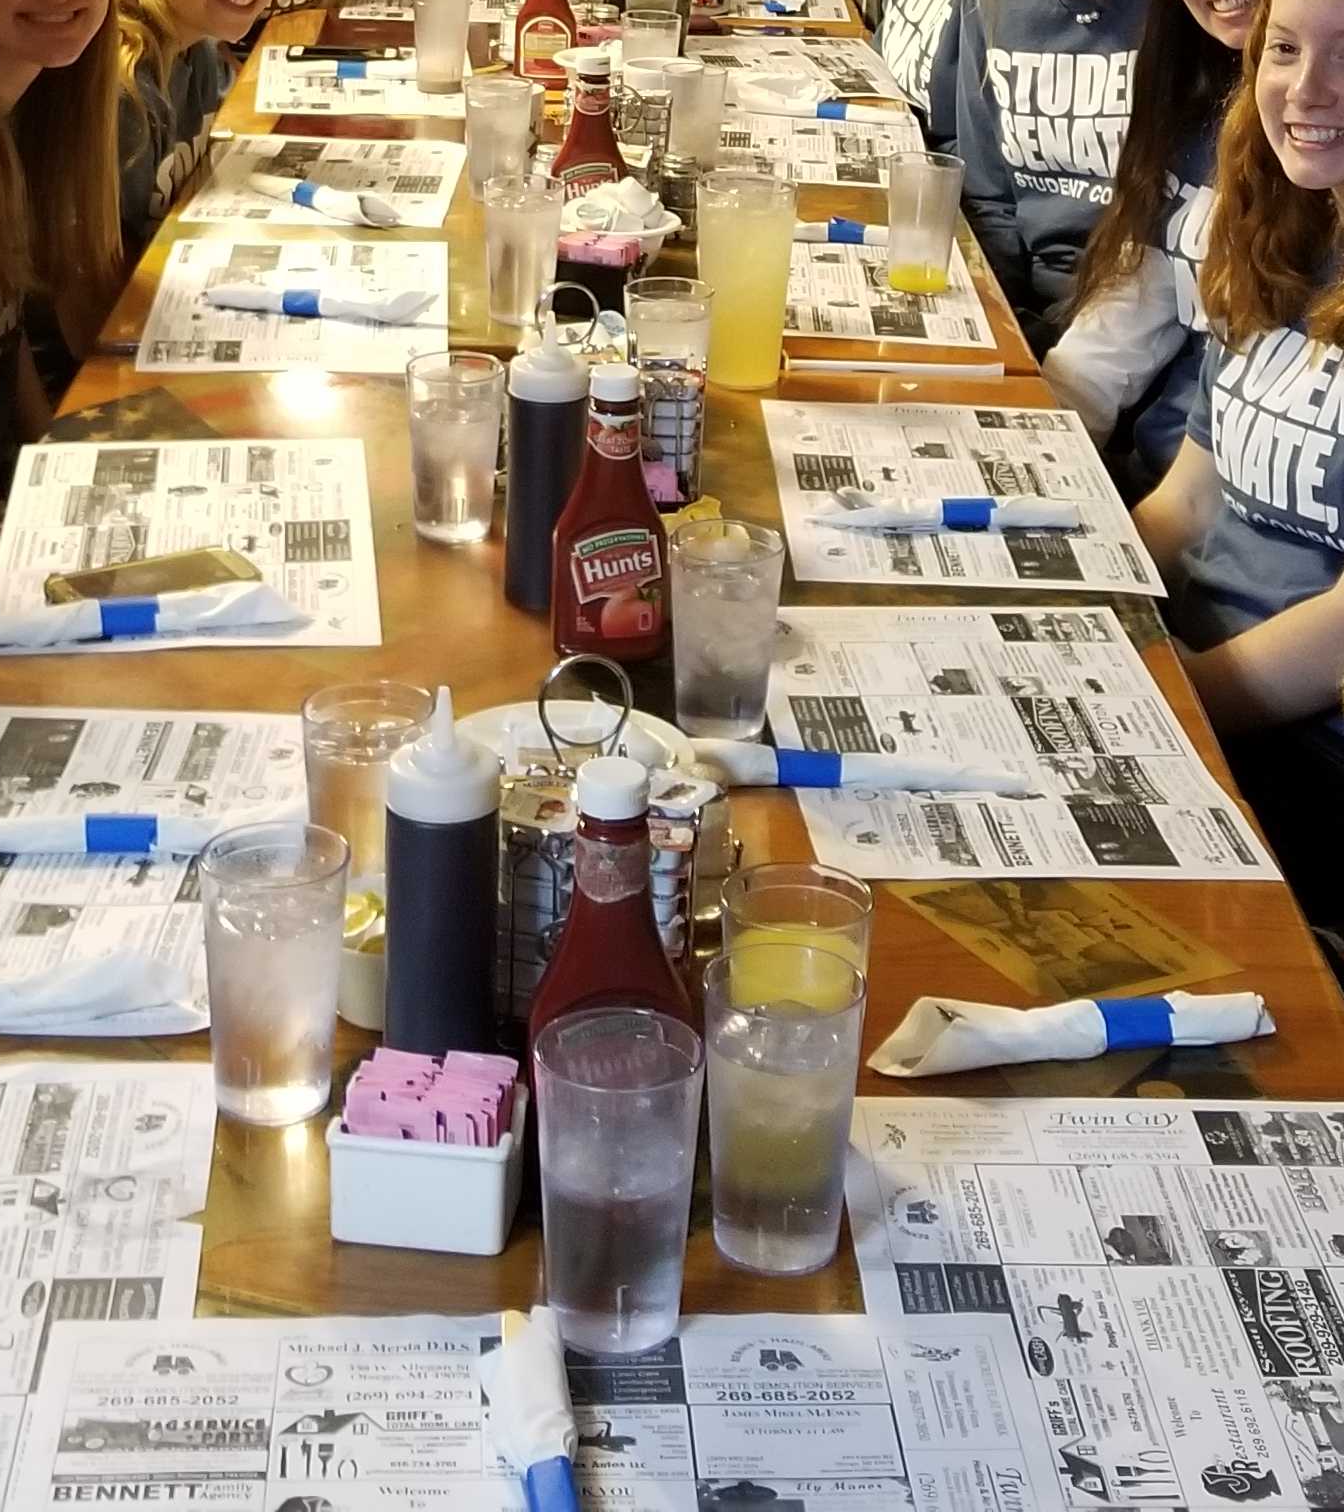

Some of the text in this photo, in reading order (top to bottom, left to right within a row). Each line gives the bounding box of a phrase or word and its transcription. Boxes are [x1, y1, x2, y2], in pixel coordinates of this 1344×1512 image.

[1001, 109, 1130, 178] SENAT
[1014, 172, 1113, 205] STUDENT CO
[1211, 384, 1338, 523] ENATE
[1000, 822, 1032, 865] BENNETT
[1049, 1111, 1178, 1127] Twin City
[961, 1179, 992, 1249] 269-685-2052
[1140, 1319, 1162, 1352] THANK
[1260, 1269, 1322, 1376] ROOFING
[1295, 1279, 1342, 1366] 269-929-3149
[1250, 1329, 1275, 1373] Scott
[97, 1394, 239, 1406] 269-685-2052
[716, 1390, 857, 1402] 269-685-2052
[183, 1418, 267, 1431] SERVICE
[1166, 1397, 1188, 1438] Welcome
[1190, 1410, 1202, 1421] To
[1211, 1389, 1261, 1473] Restaurant
[52, 1484, 202, 1502] BENNETT
[378, 1486, 450, 1495] Welcome
